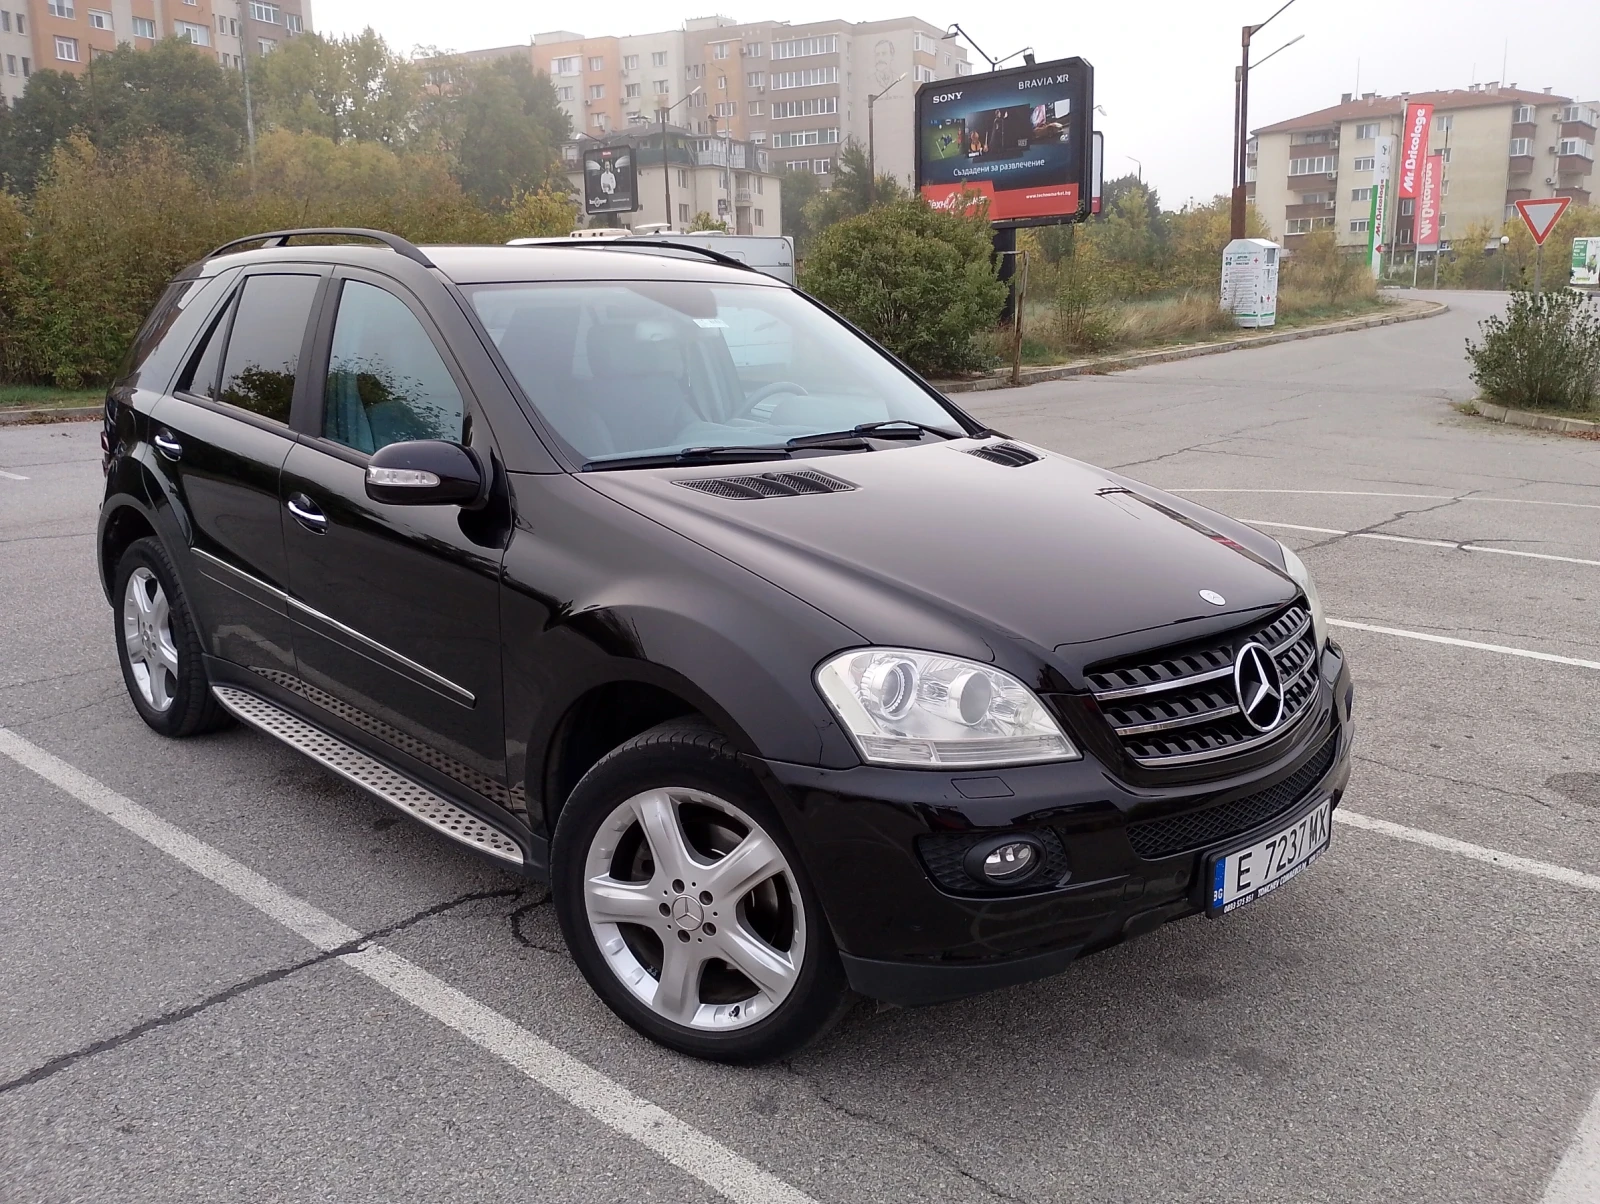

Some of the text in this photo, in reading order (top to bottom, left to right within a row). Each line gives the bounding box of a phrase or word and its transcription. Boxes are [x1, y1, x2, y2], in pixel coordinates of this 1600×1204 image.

[1018, 73, 1069, 90] BRAVIA XR
[932, 91, 963, 104] SONY
[953, 159, 1045, 177] Създадени за развлечение
[1236, 851, 1253, 893] E
[1263, 819, 1307, 881] 7237
[1308, 803, 1329, 851] MX
[1213, 888, 1224, 902] BG
